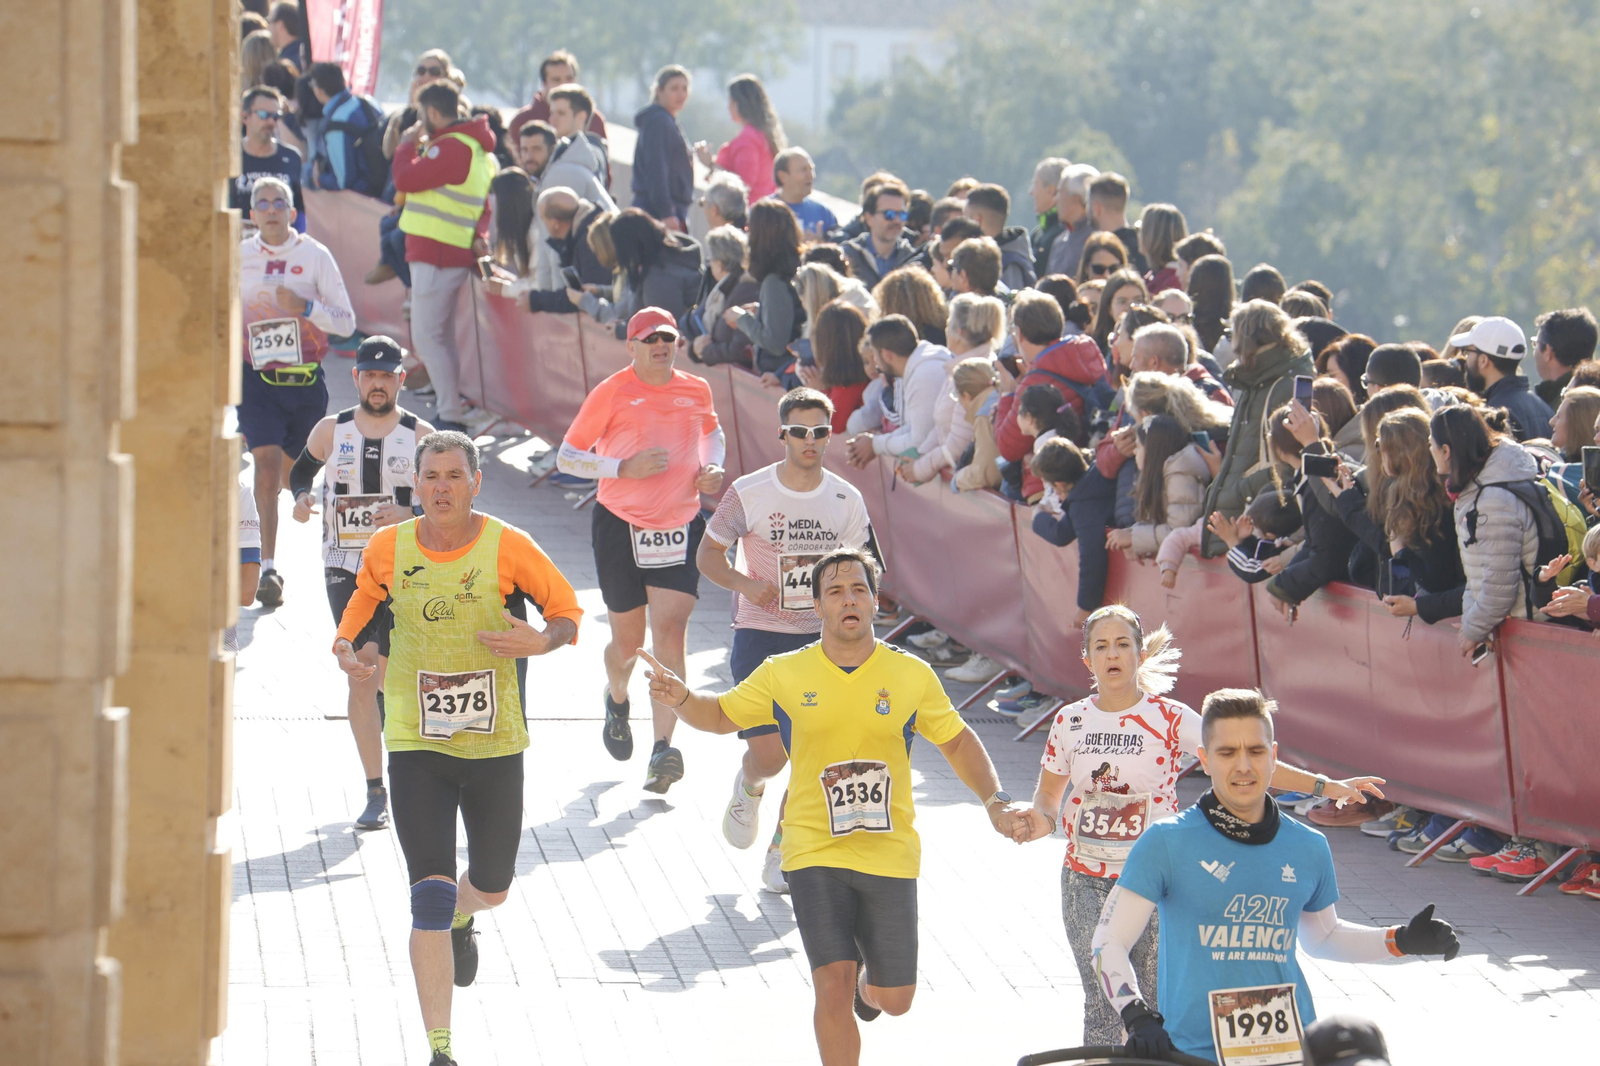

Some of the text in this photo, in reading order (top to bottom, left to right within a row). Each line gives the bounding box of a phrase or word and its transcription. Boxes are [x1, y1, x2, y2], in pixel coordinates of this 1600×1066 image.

[254, 333, 295, 350] 2596
[788, 519, 822, 530] MEDIA
[639, 530, 685, 548] 4810
[770, 529, 785, 541] 37
[426, 690, 488, 715] 2378
[1084, 732, 1144, 747] GUERRERAS
[831, 781, 883, 808] 2536
[1080, 810, 1142, 837] 3543
[1223, 893, 1290, 926] 42K
[1211, 951, 1226, 961] WE
[1227, 951, 1246, 961] ARE
[1225, 1009, 1289, 1039] 1998
